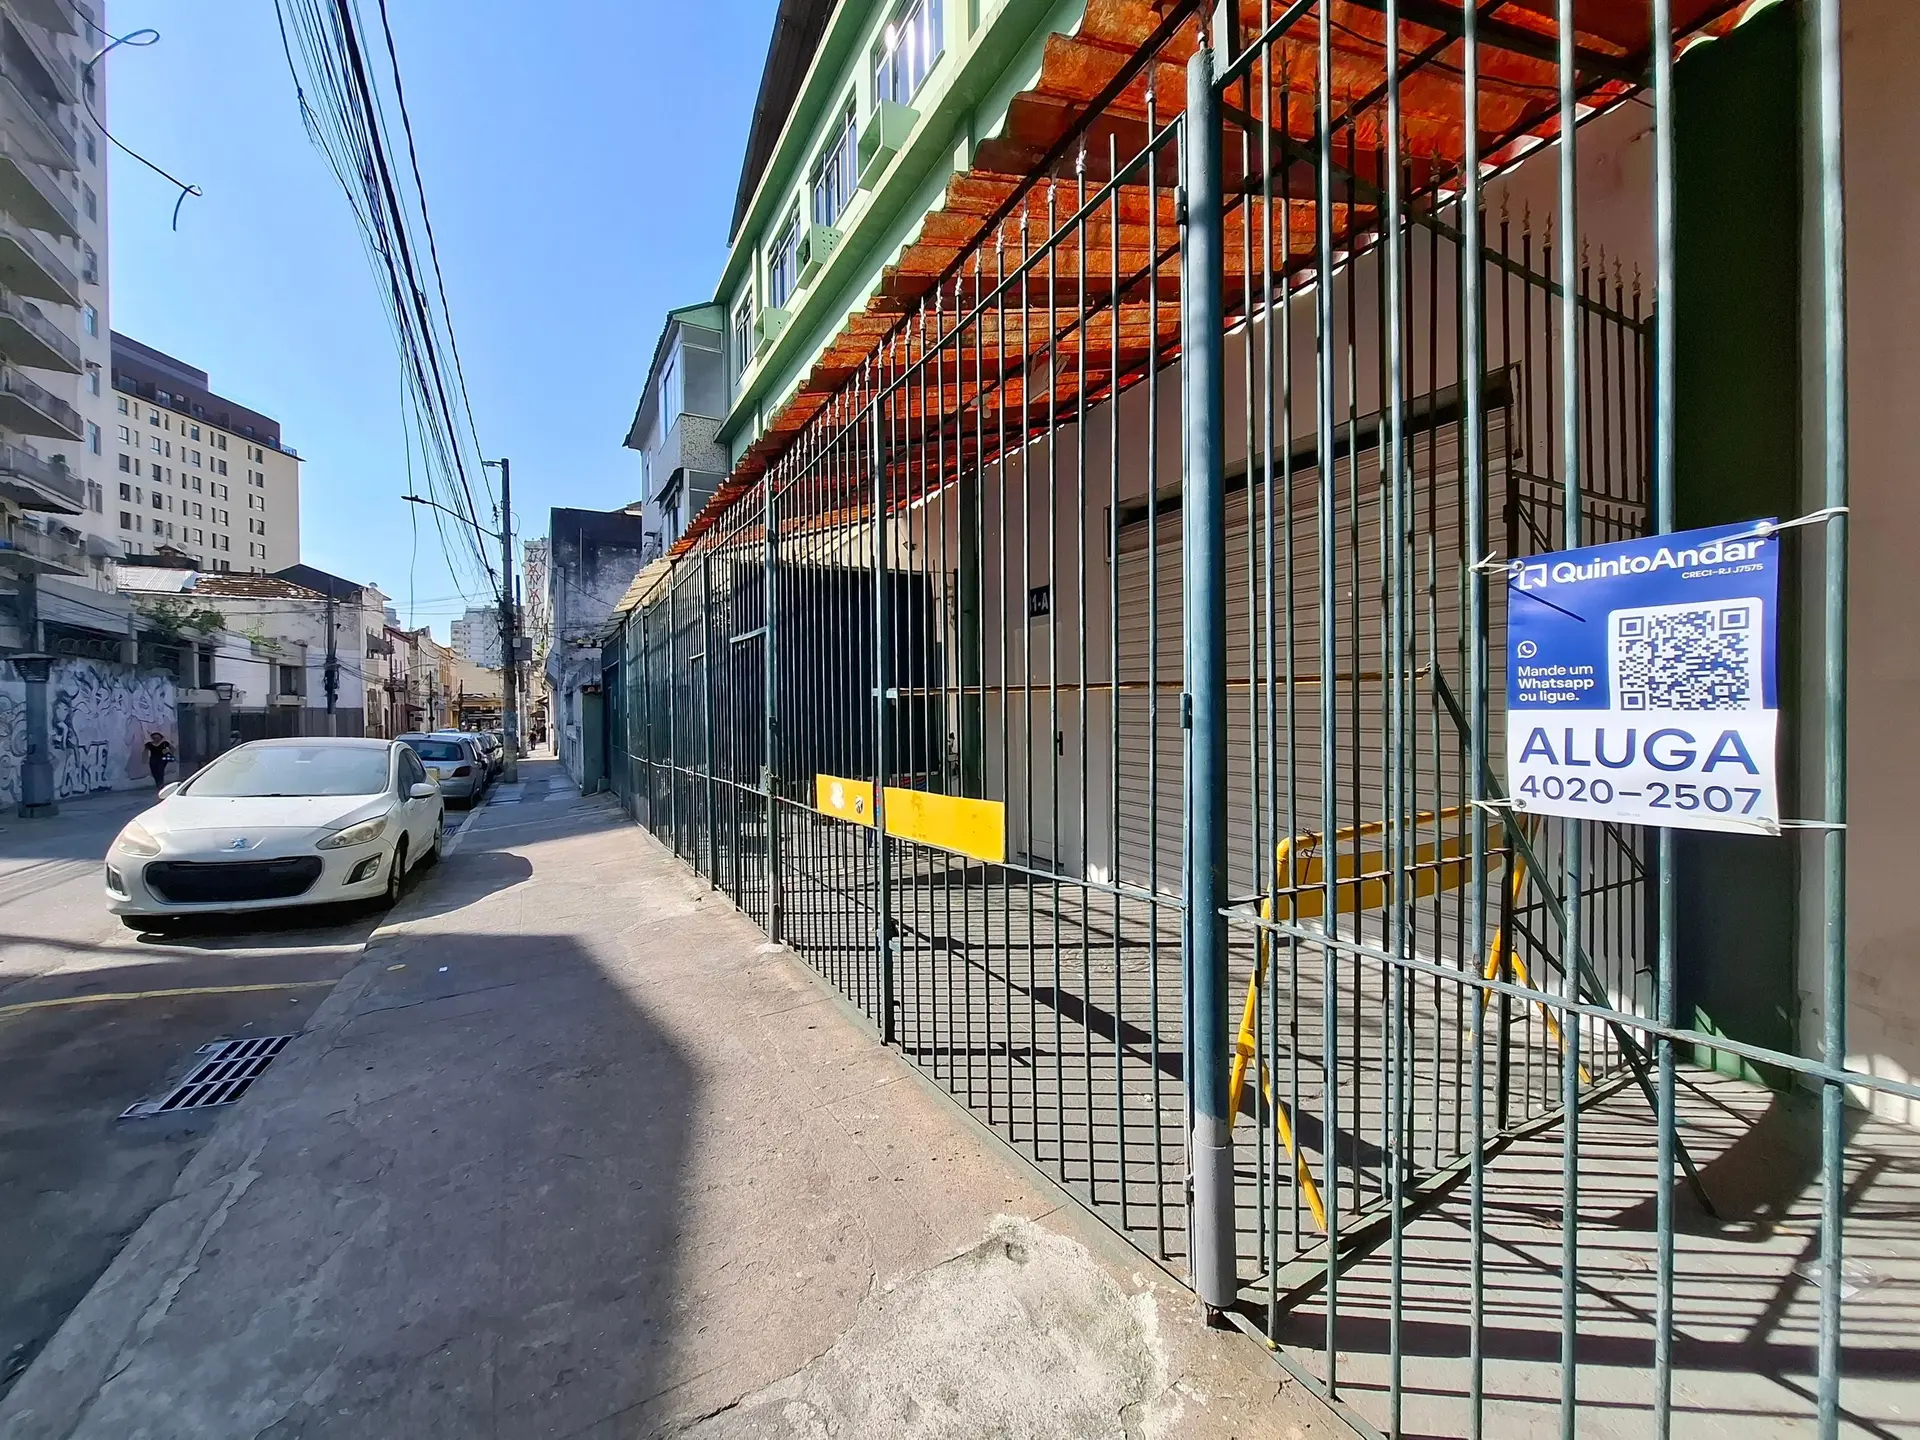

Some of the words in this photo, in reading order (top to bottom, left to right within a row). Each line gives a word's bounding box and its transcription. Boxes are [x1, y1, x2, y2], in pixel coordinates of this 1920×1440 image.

[1552, 540, 1765, 584] QuintoAndar
[1681, 567, 1731, 580] CRECI-RJ
[1732, 563, 1764, 574] J7575
[1518, 664, 1567, 677] Mande
[1569, 665, 1594, 675] um
[1517, 678, 1595, 691] Whatsapp
[1519, 692, 1537, 702] ou
[1539, 690, 1580, 704] ligue.
[1519, 727, 1760, 775] ALUGA
[1519, 775, 1762, 815] 4020-2507
